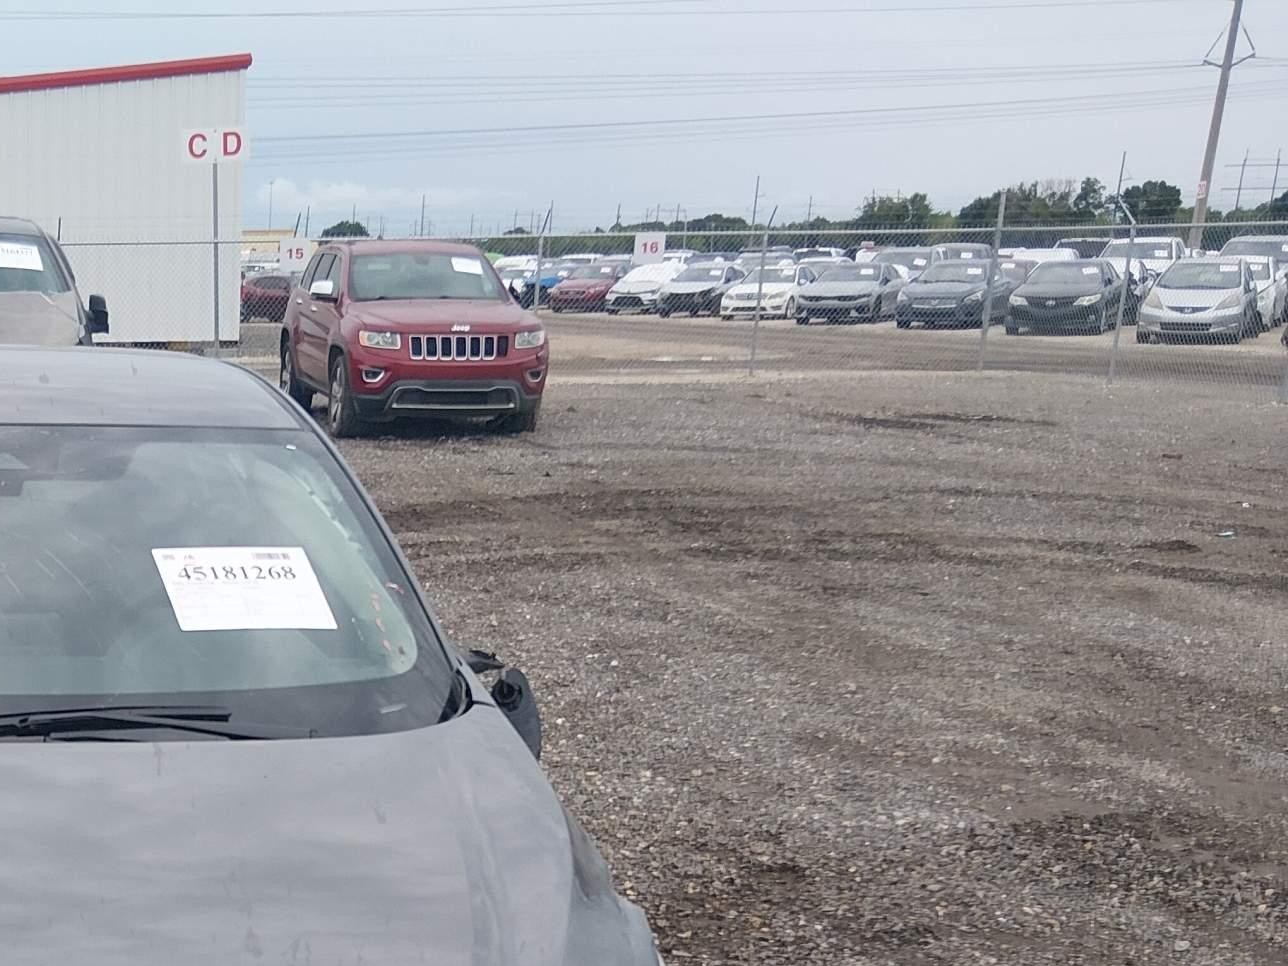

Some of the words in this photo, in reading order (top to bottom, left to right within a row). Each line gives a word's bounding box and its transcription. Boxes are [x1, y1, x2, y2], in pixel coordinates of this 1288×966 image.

[188, 133, 207, 159] C
[222, 131, 242, 156] D
[286, 247, 304, 260] 15
[641, 241, 659, 254] 16
[178, 565, 297, 581] 45181268
